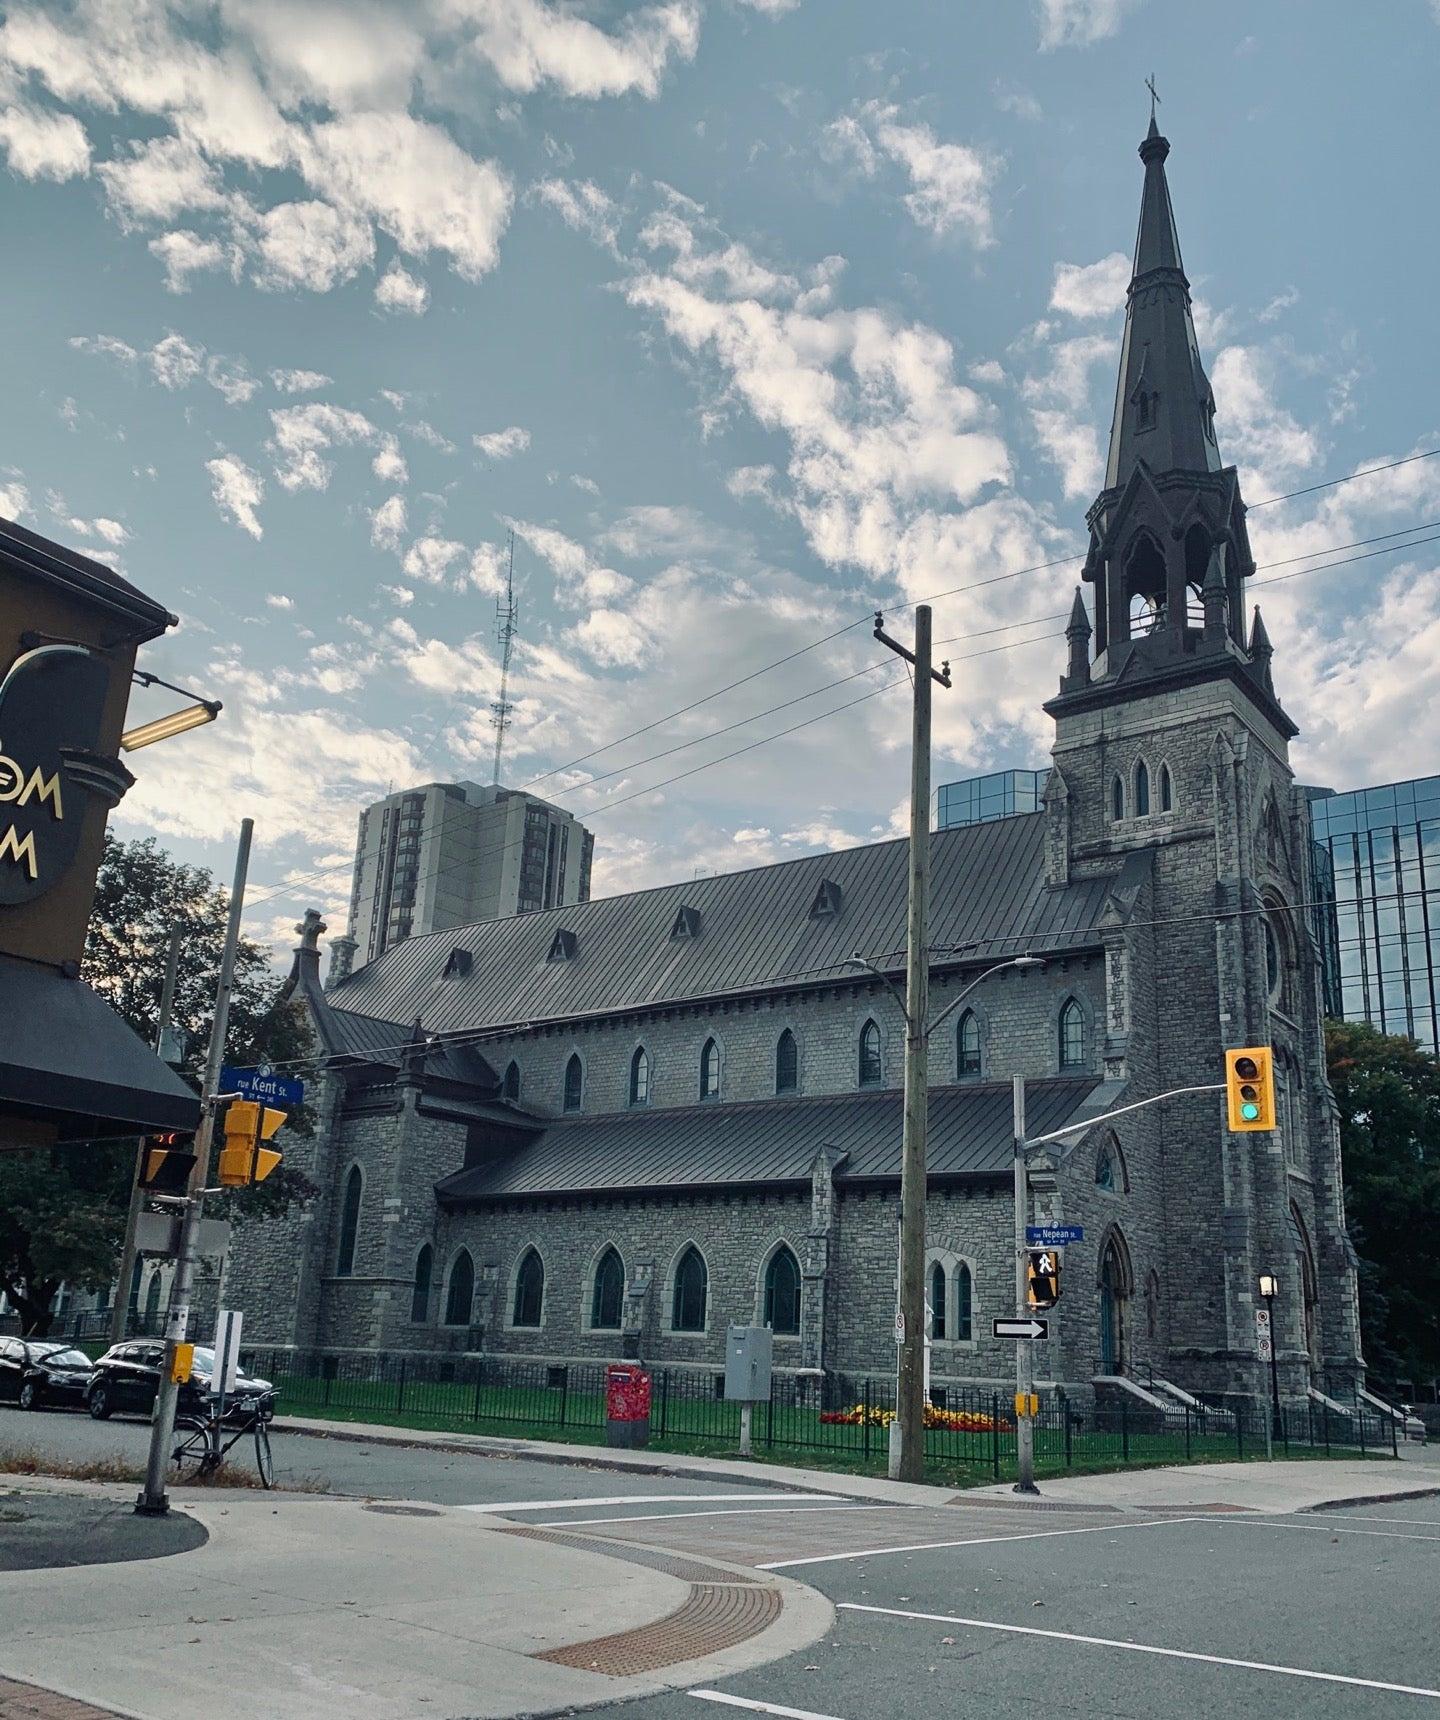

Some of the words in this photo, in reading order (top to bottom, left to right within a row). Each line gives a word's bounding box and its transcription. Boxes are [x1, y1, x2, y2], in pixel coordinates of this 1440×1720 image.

[237, 1080, 249, 1089] rue
[252, 1076, 277, 1095] Kent
[1042, 1229, 1069, 1241] Nepean
